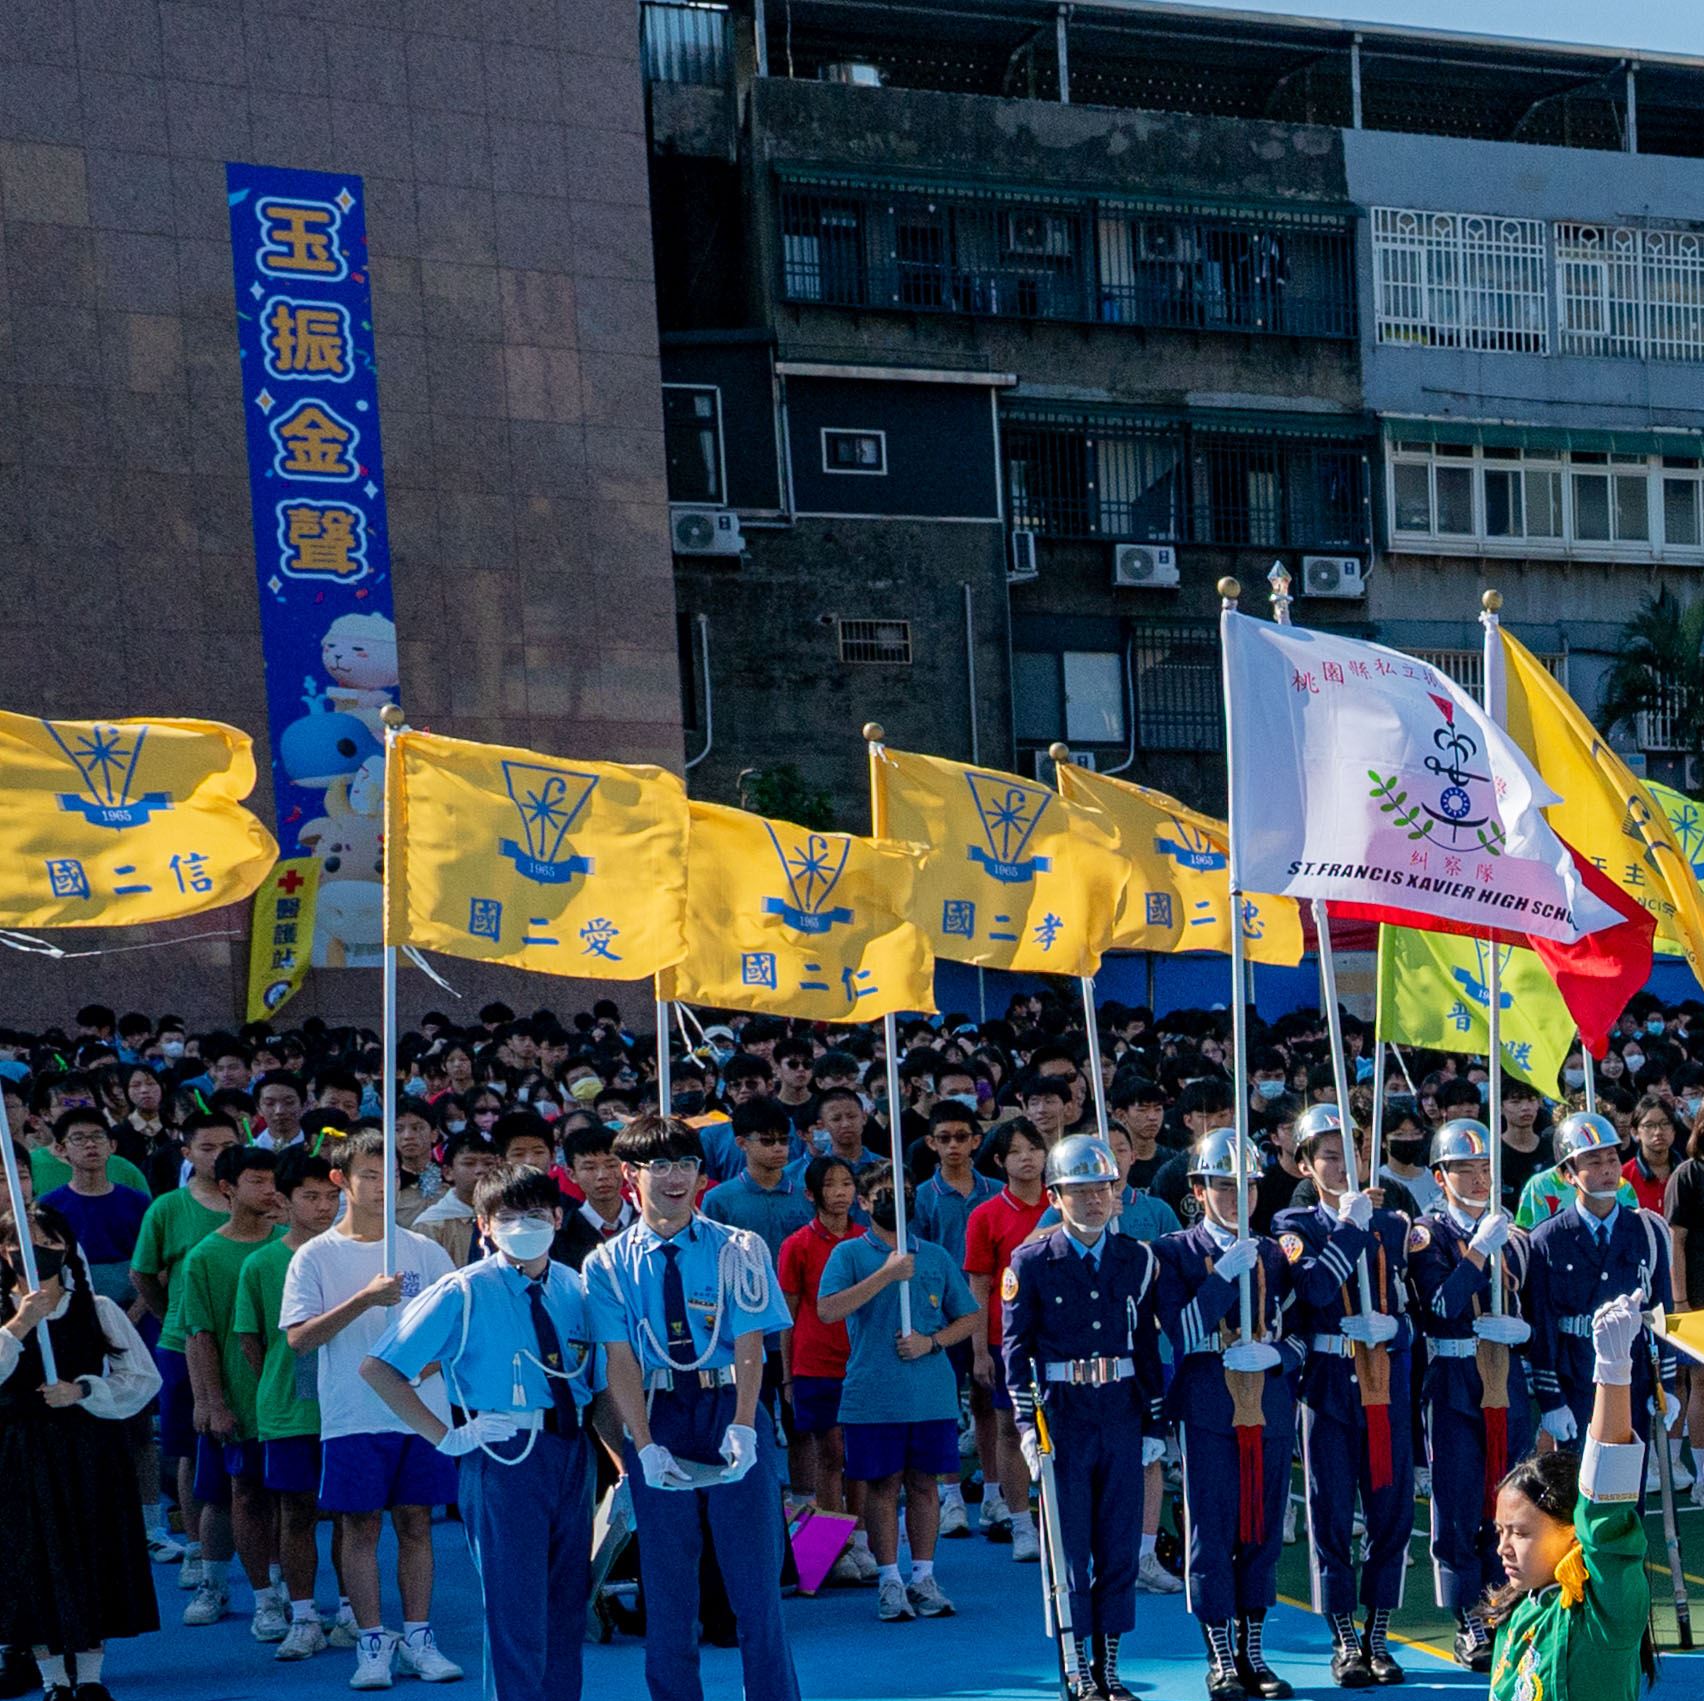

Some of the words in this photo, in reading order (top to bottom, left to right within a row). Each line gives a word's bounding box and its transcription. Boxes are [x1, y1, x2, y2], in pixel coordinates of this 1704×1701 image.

[262, 202, 364, 578] 玉振金聲
[101, 809, 132, 822] 1965
[45, 853, 213, 900] 國二信
[529, 862, 556, 878] 1965
[1190, 853, 1214, 866] 1965
[1407, 873, 1476, 901] XAVIER
[1477, 888, 1529, 912] HIGH
[469, 897, 622, 961] 國二愛
[942, 899, 1063, 952] 國二孝
[741, 952, 878, 1002] 國二仁
